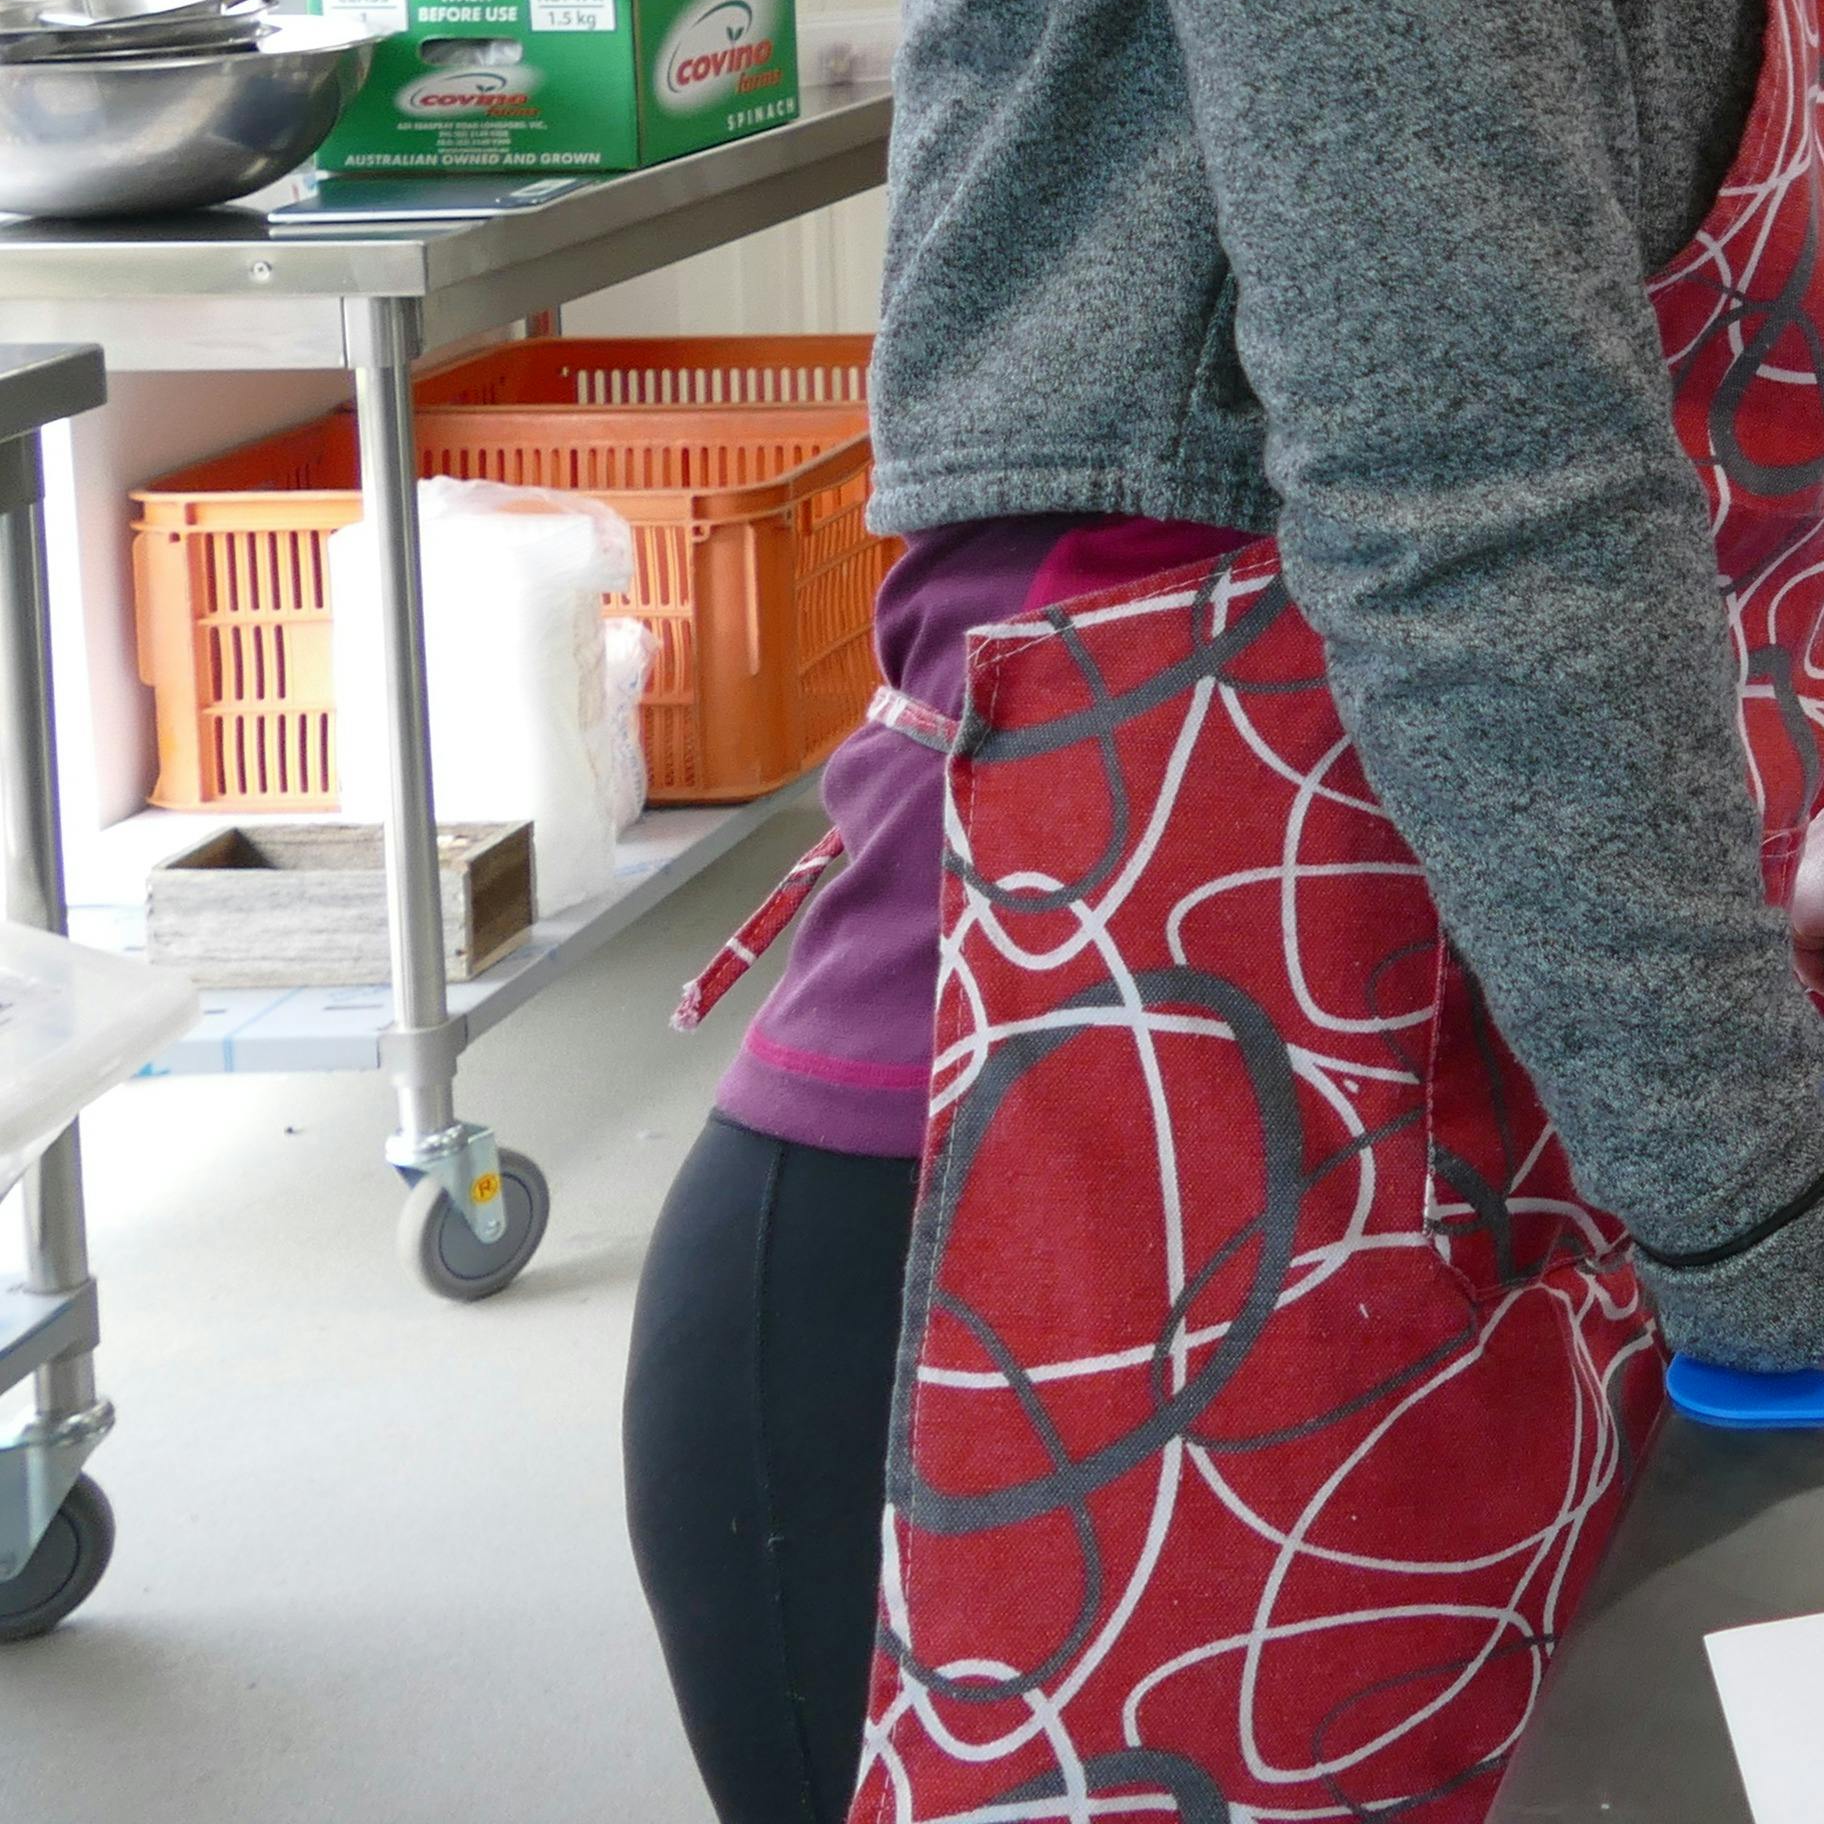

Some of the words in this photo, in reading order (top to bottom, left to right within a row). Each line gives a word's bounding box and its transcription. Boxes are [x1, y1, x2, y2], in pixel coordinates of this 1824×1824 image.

[418, 7, 481, 23] BEFORE
[485, 6, 519, 22] USE
[549, 11, 572, 25] 1.5
[577, 10, 598, 28] kg
[676, 39, 773, 87] covino
[735, 68, 782, 94] farms
[419, 93, 529, 107] covino
[727, 97, 796, 131] SPINACH
[345, 154, 438, 167] AUSTRALIAN
[442, 153, 500, 166] OWNED
[502, 152, 536, 166] AND
[540, 152, 601, 165] GROWN
